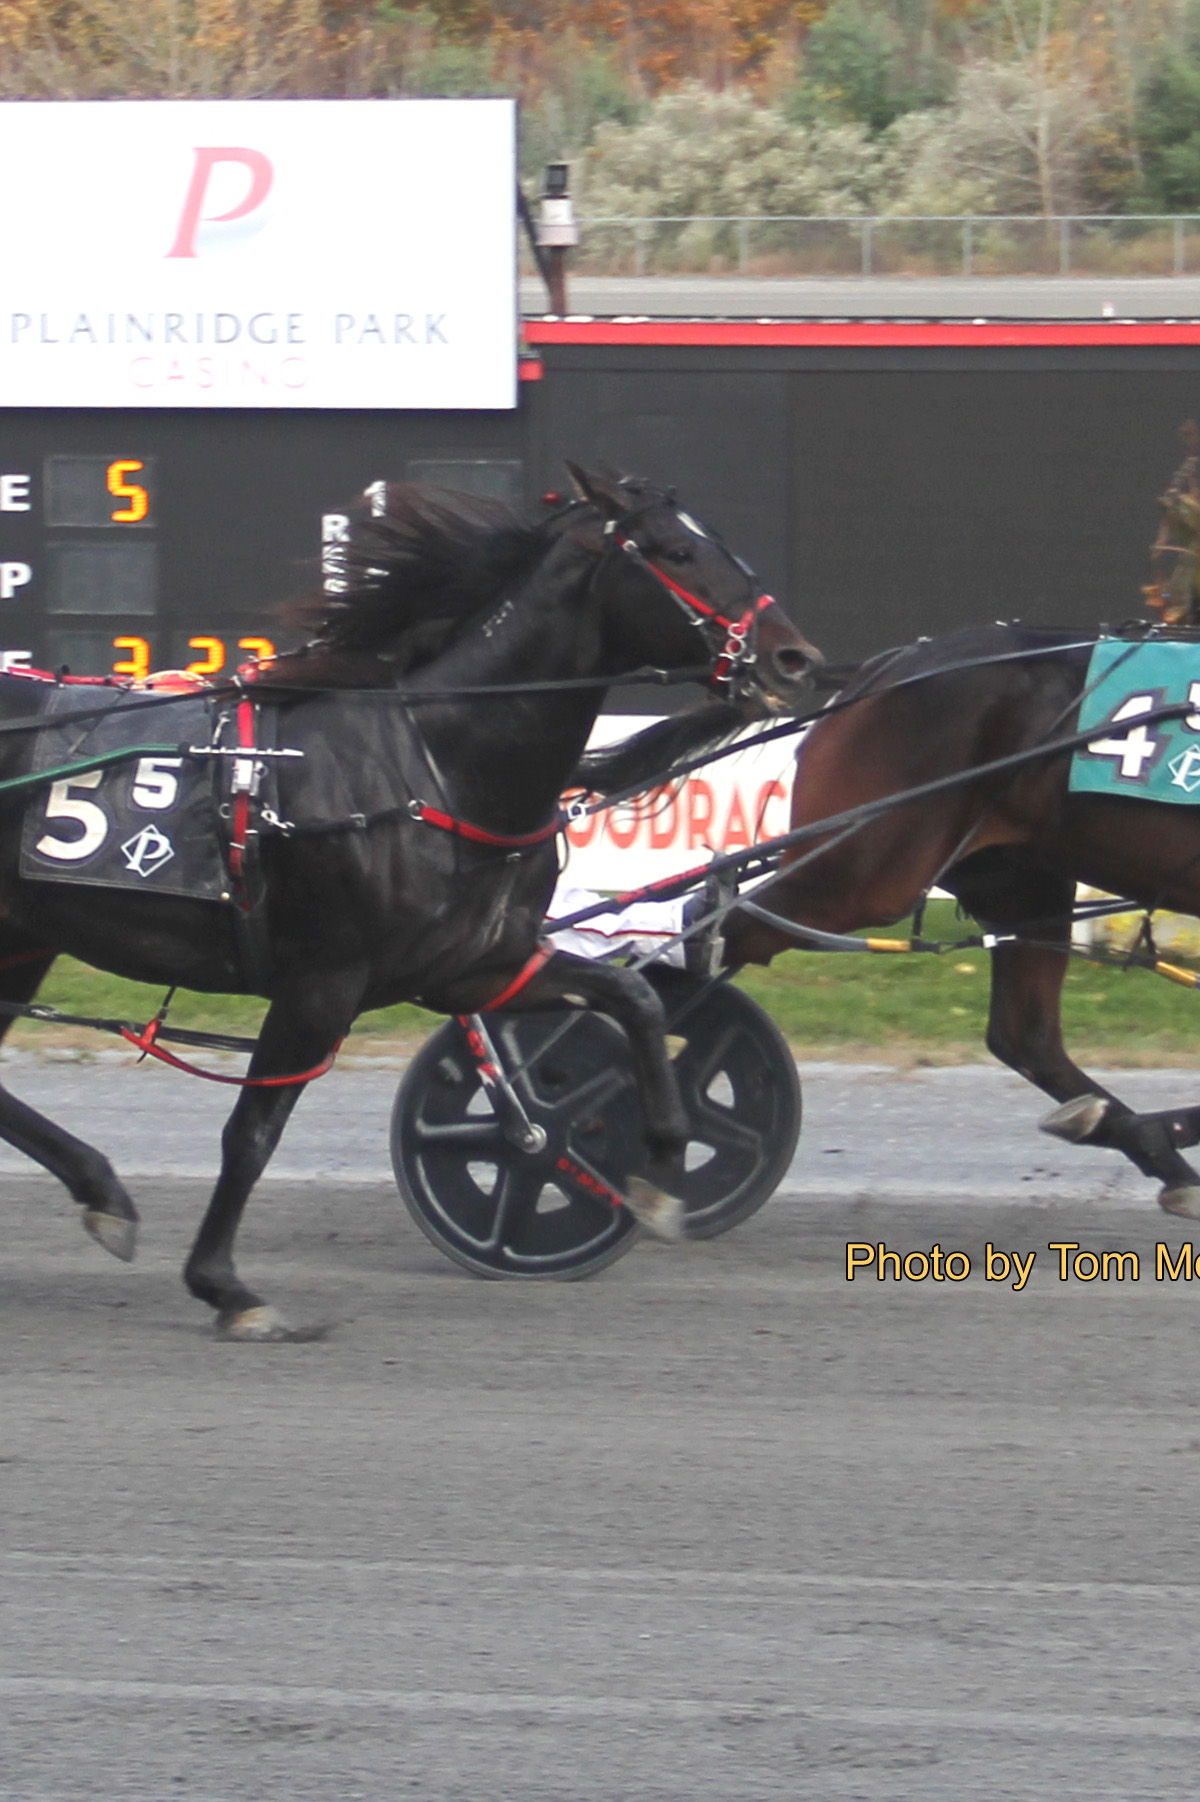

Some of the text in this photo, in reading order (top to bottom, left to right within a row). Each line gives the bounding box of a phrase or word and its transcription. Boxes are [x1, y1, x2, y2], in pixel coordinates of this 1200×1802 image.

[163, 146, 275, 258] P
[9, 312, 450, 345] PLAINRIDGE PARK
[128, 356, 309, 389] CASINO
[107, 459, 149, 523] 5
[1088, 696, 1156, 777] 4
[36, 770, 109, 860] 5
[132, 757, 183, 809] 5
